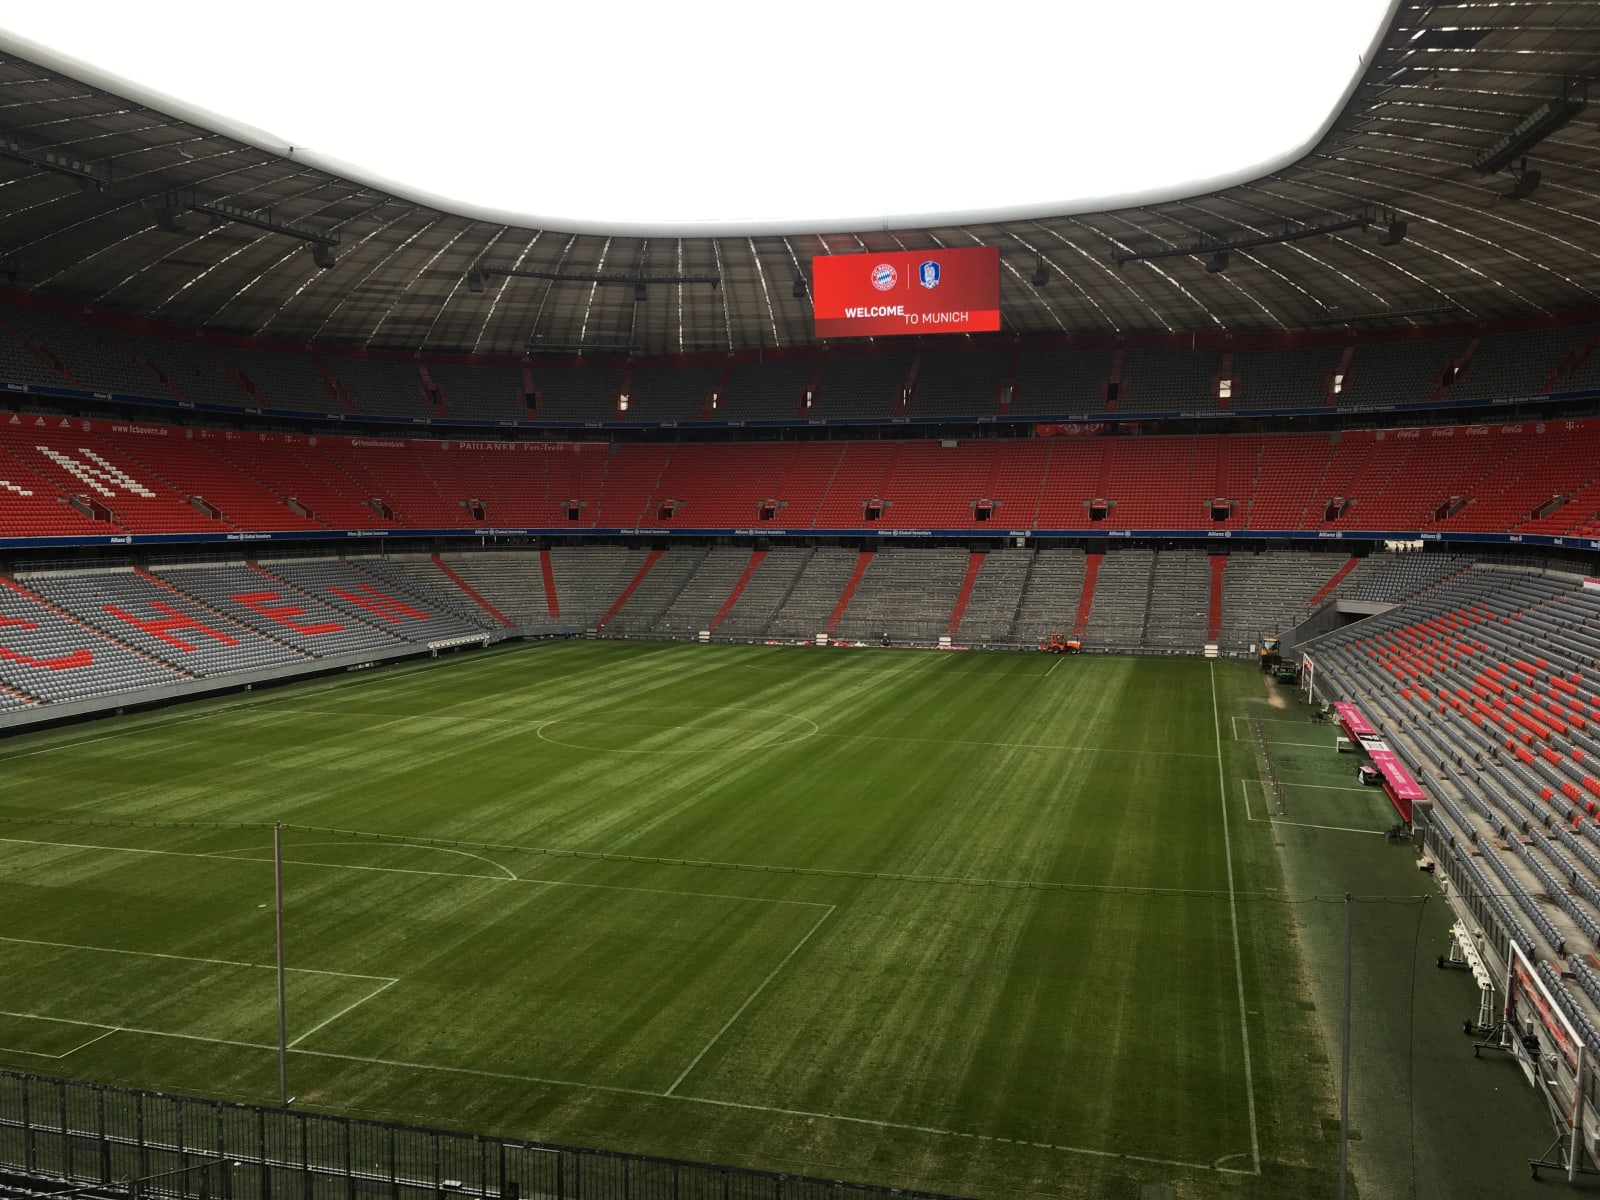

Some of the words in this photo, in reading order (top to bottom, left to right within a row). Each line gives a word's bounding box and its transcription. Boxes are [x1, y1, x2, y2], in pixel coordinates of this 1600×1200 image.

[845, 305, 905, 318] WELCOME
[904, 313, 919, 325] TO
[922, 311, 969, 324] MUNICH
